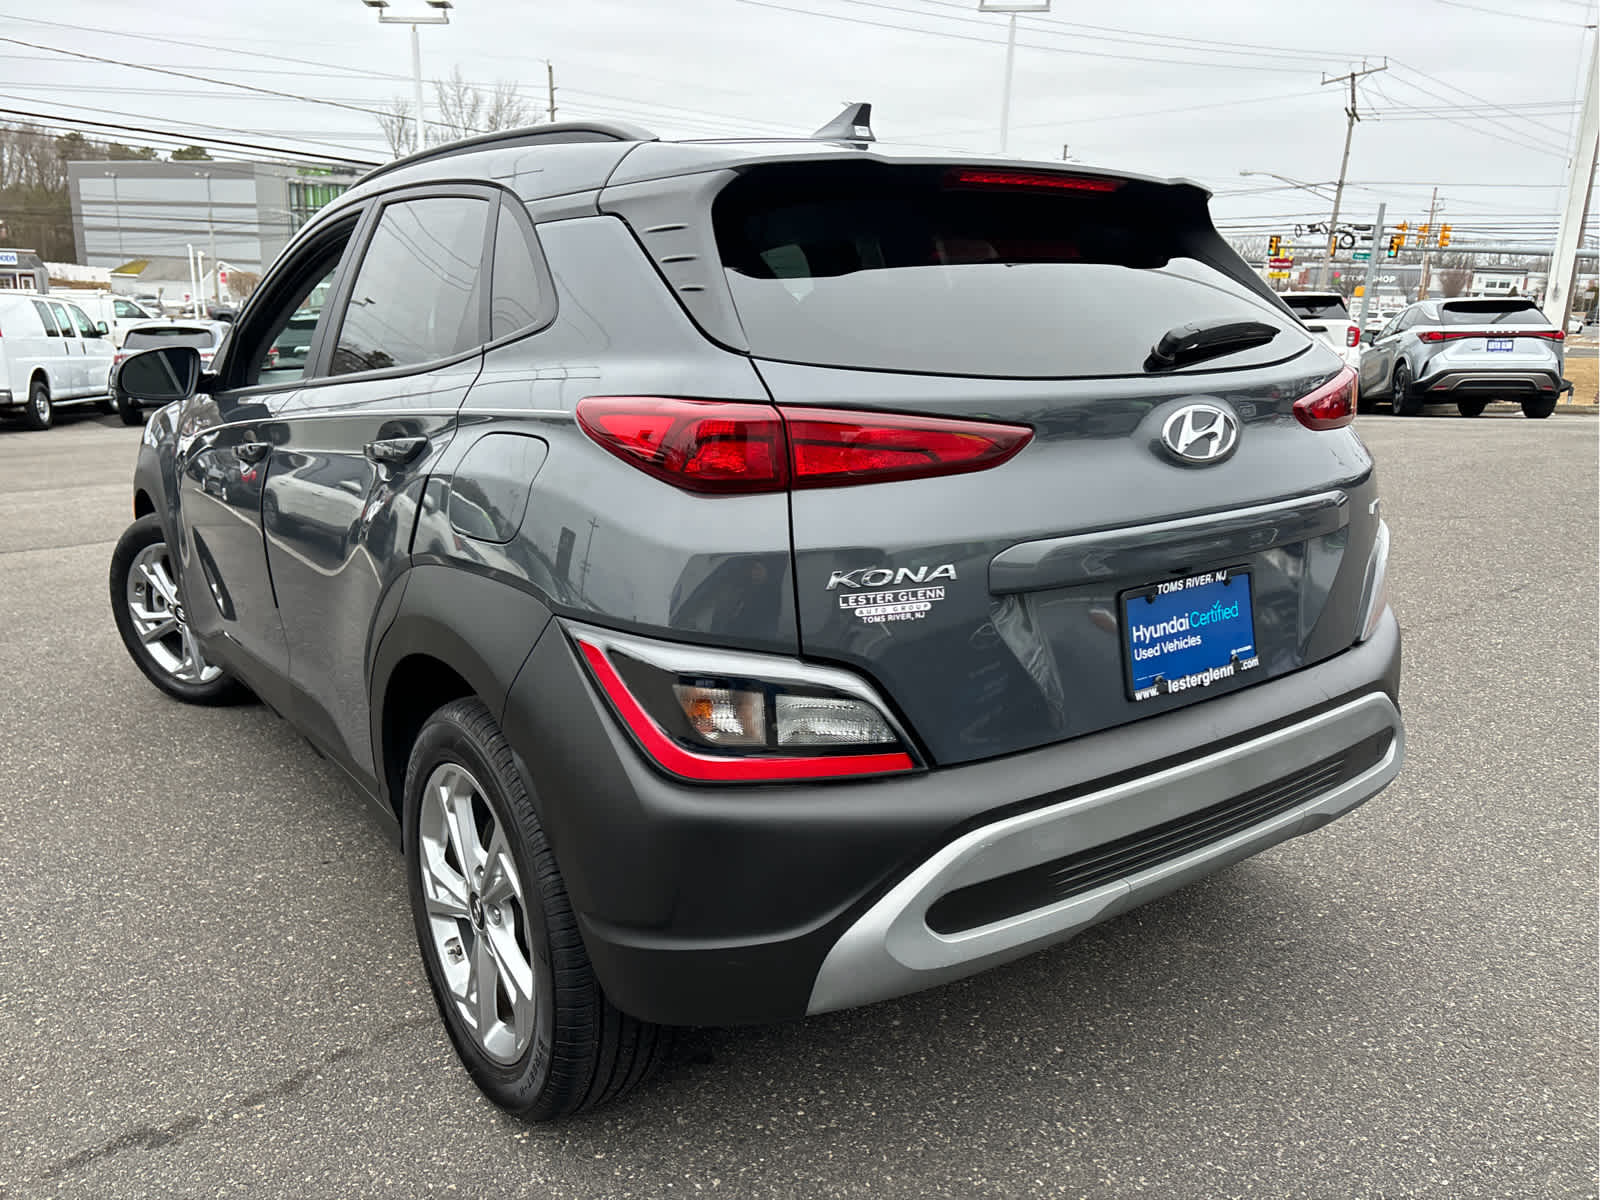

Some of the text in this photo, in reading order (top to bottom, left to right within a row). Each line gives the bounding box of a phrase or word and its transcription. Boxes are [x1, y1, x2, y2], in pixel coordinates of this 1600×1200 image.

[825, 563, 958, 590] KONA
[1157, 580, 1184, 595] TOMS
[1215, 570, 1228, 582] NJ
[839, 588, 945, 607] LESTER GLENN
[857, 603, 931, 616] AUTO GROUP
[862, 615, 886, 624] TOMS
[916, 611, 926, 619] NJ
[1132, 600, 1239, 643] Hyundai Certified
[1134, 634, 1202, 661] Used Vehicles
[1135, 687, 1160, 701] www.
[1167, 663, 1235, 693] lesterglenn
[1240, 657, 1259, 671] .com
